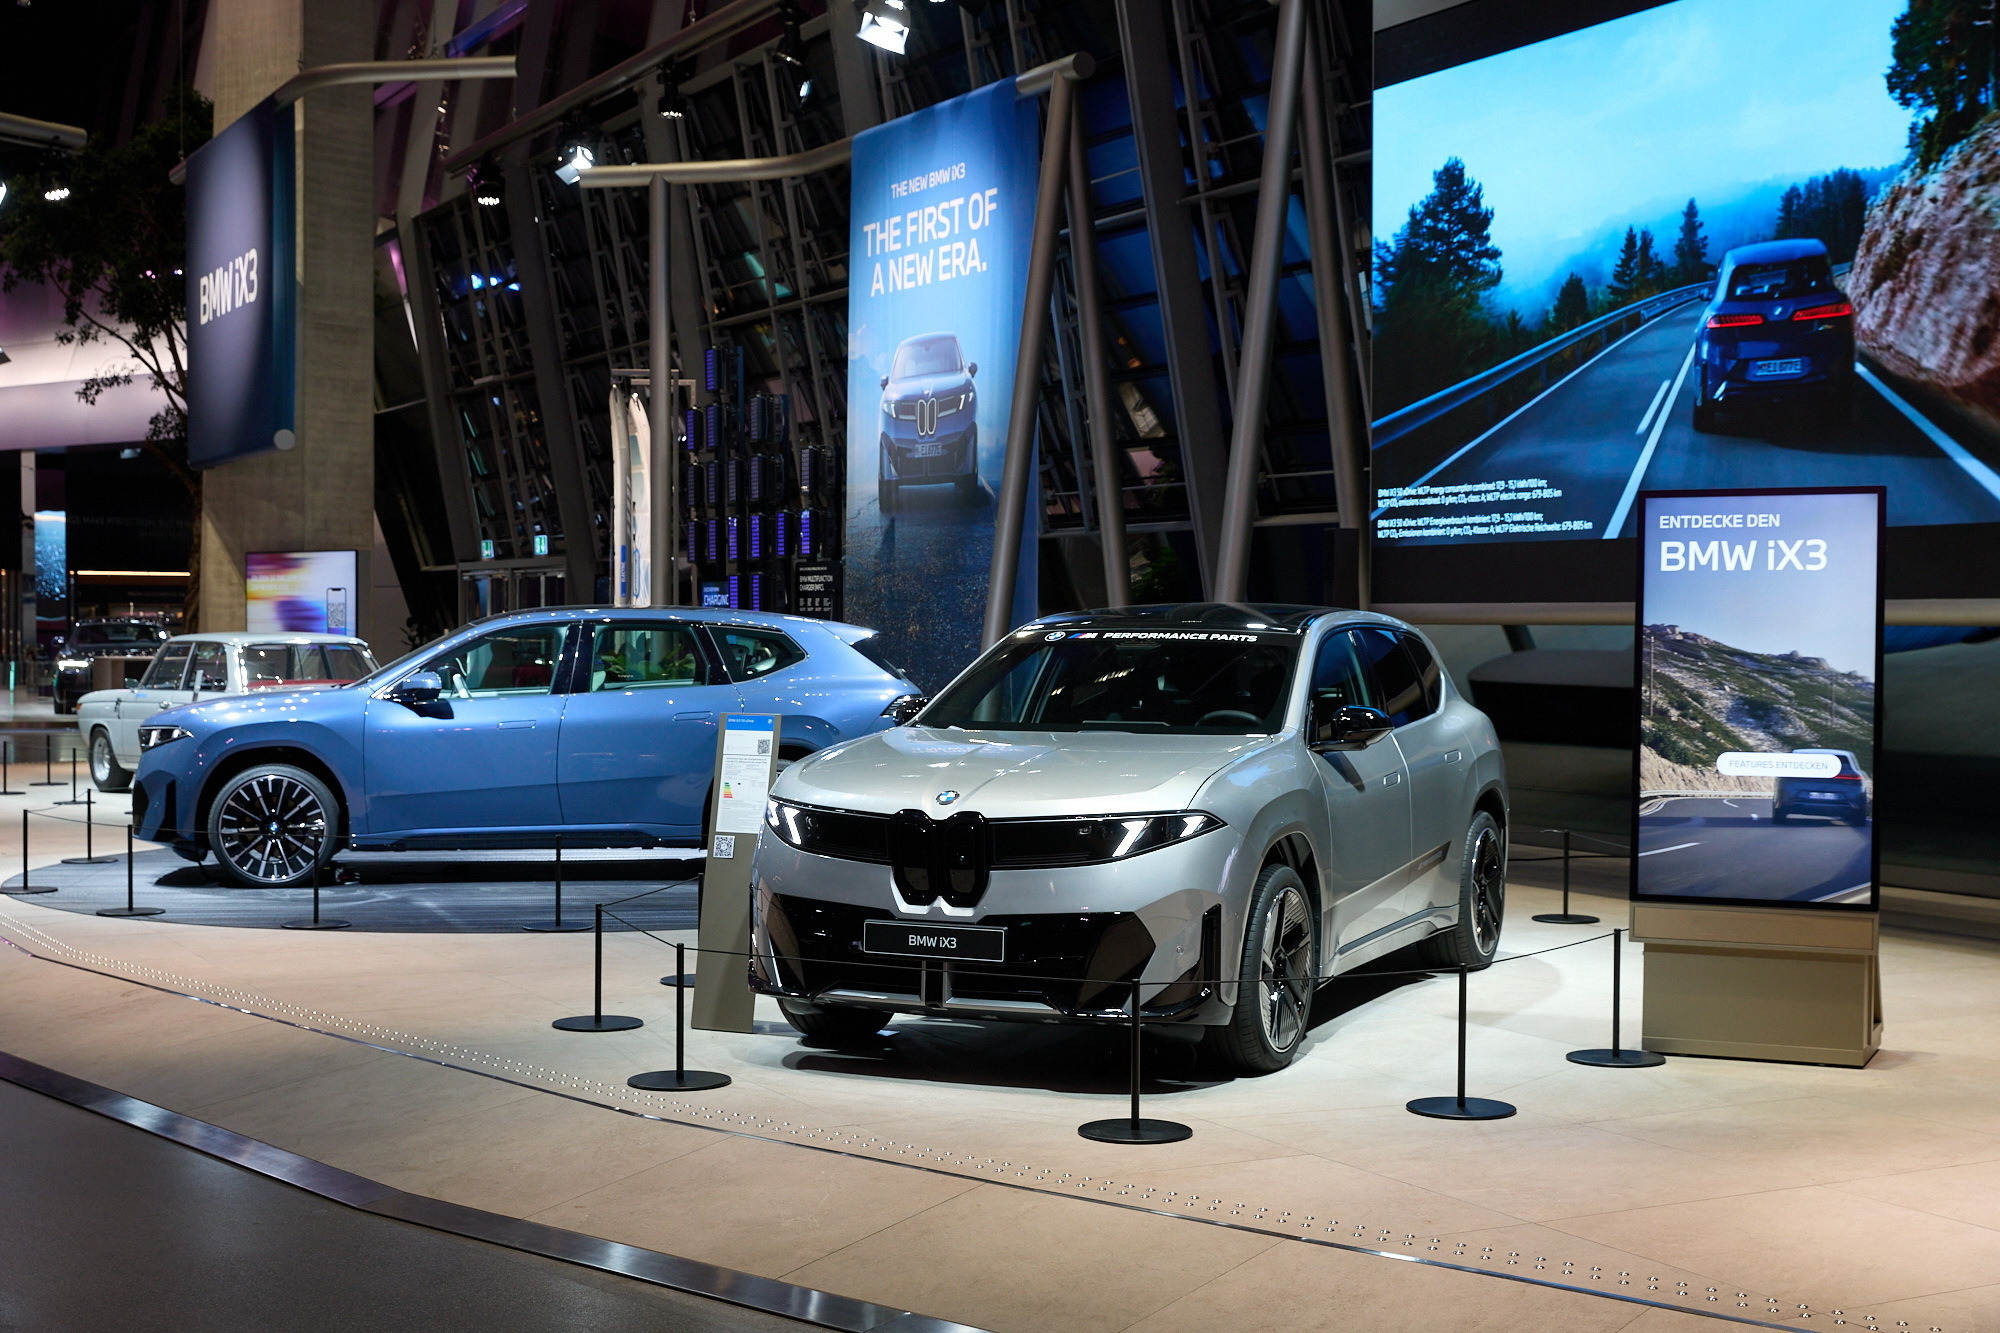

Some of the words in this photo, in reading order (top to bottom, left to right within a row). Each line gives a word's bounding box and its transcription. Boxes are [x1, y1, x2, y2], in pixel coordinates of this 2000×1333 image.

[891, 181, 908, 199] THE
[908, 174, 928, 194] NEW
[929, 167, 950, 188] BMW
[952, 162, 966, 182] iX3
[863, 215, 902, 257] THE
[906, 197, 964, 247] FIRST
[968, 188, 998, 230] OF
[870, 262, 885, 297] A
[889, 248, 934, 293] NEW
[938, 238, 987, 282] ERA.
[200, 261, 234, 325] BMW
[235, 248, 258, 308] iX3
[1659, 514, 1744, 529] ENTDECKE
[1746, 513, 1780, 528] DEN
[1660, 540, 1758, 572] BMW
[1768, 538, 1828, 571] iX3
[1210, 634, 1258, 642] PARTS
[1729, 760, 1774, 769] FEATURES
[1776, 761, 1828, 770] ENTDECKEN
[908, 935, 937, 948] BMW
[940, 937, 957, 949] iX3
